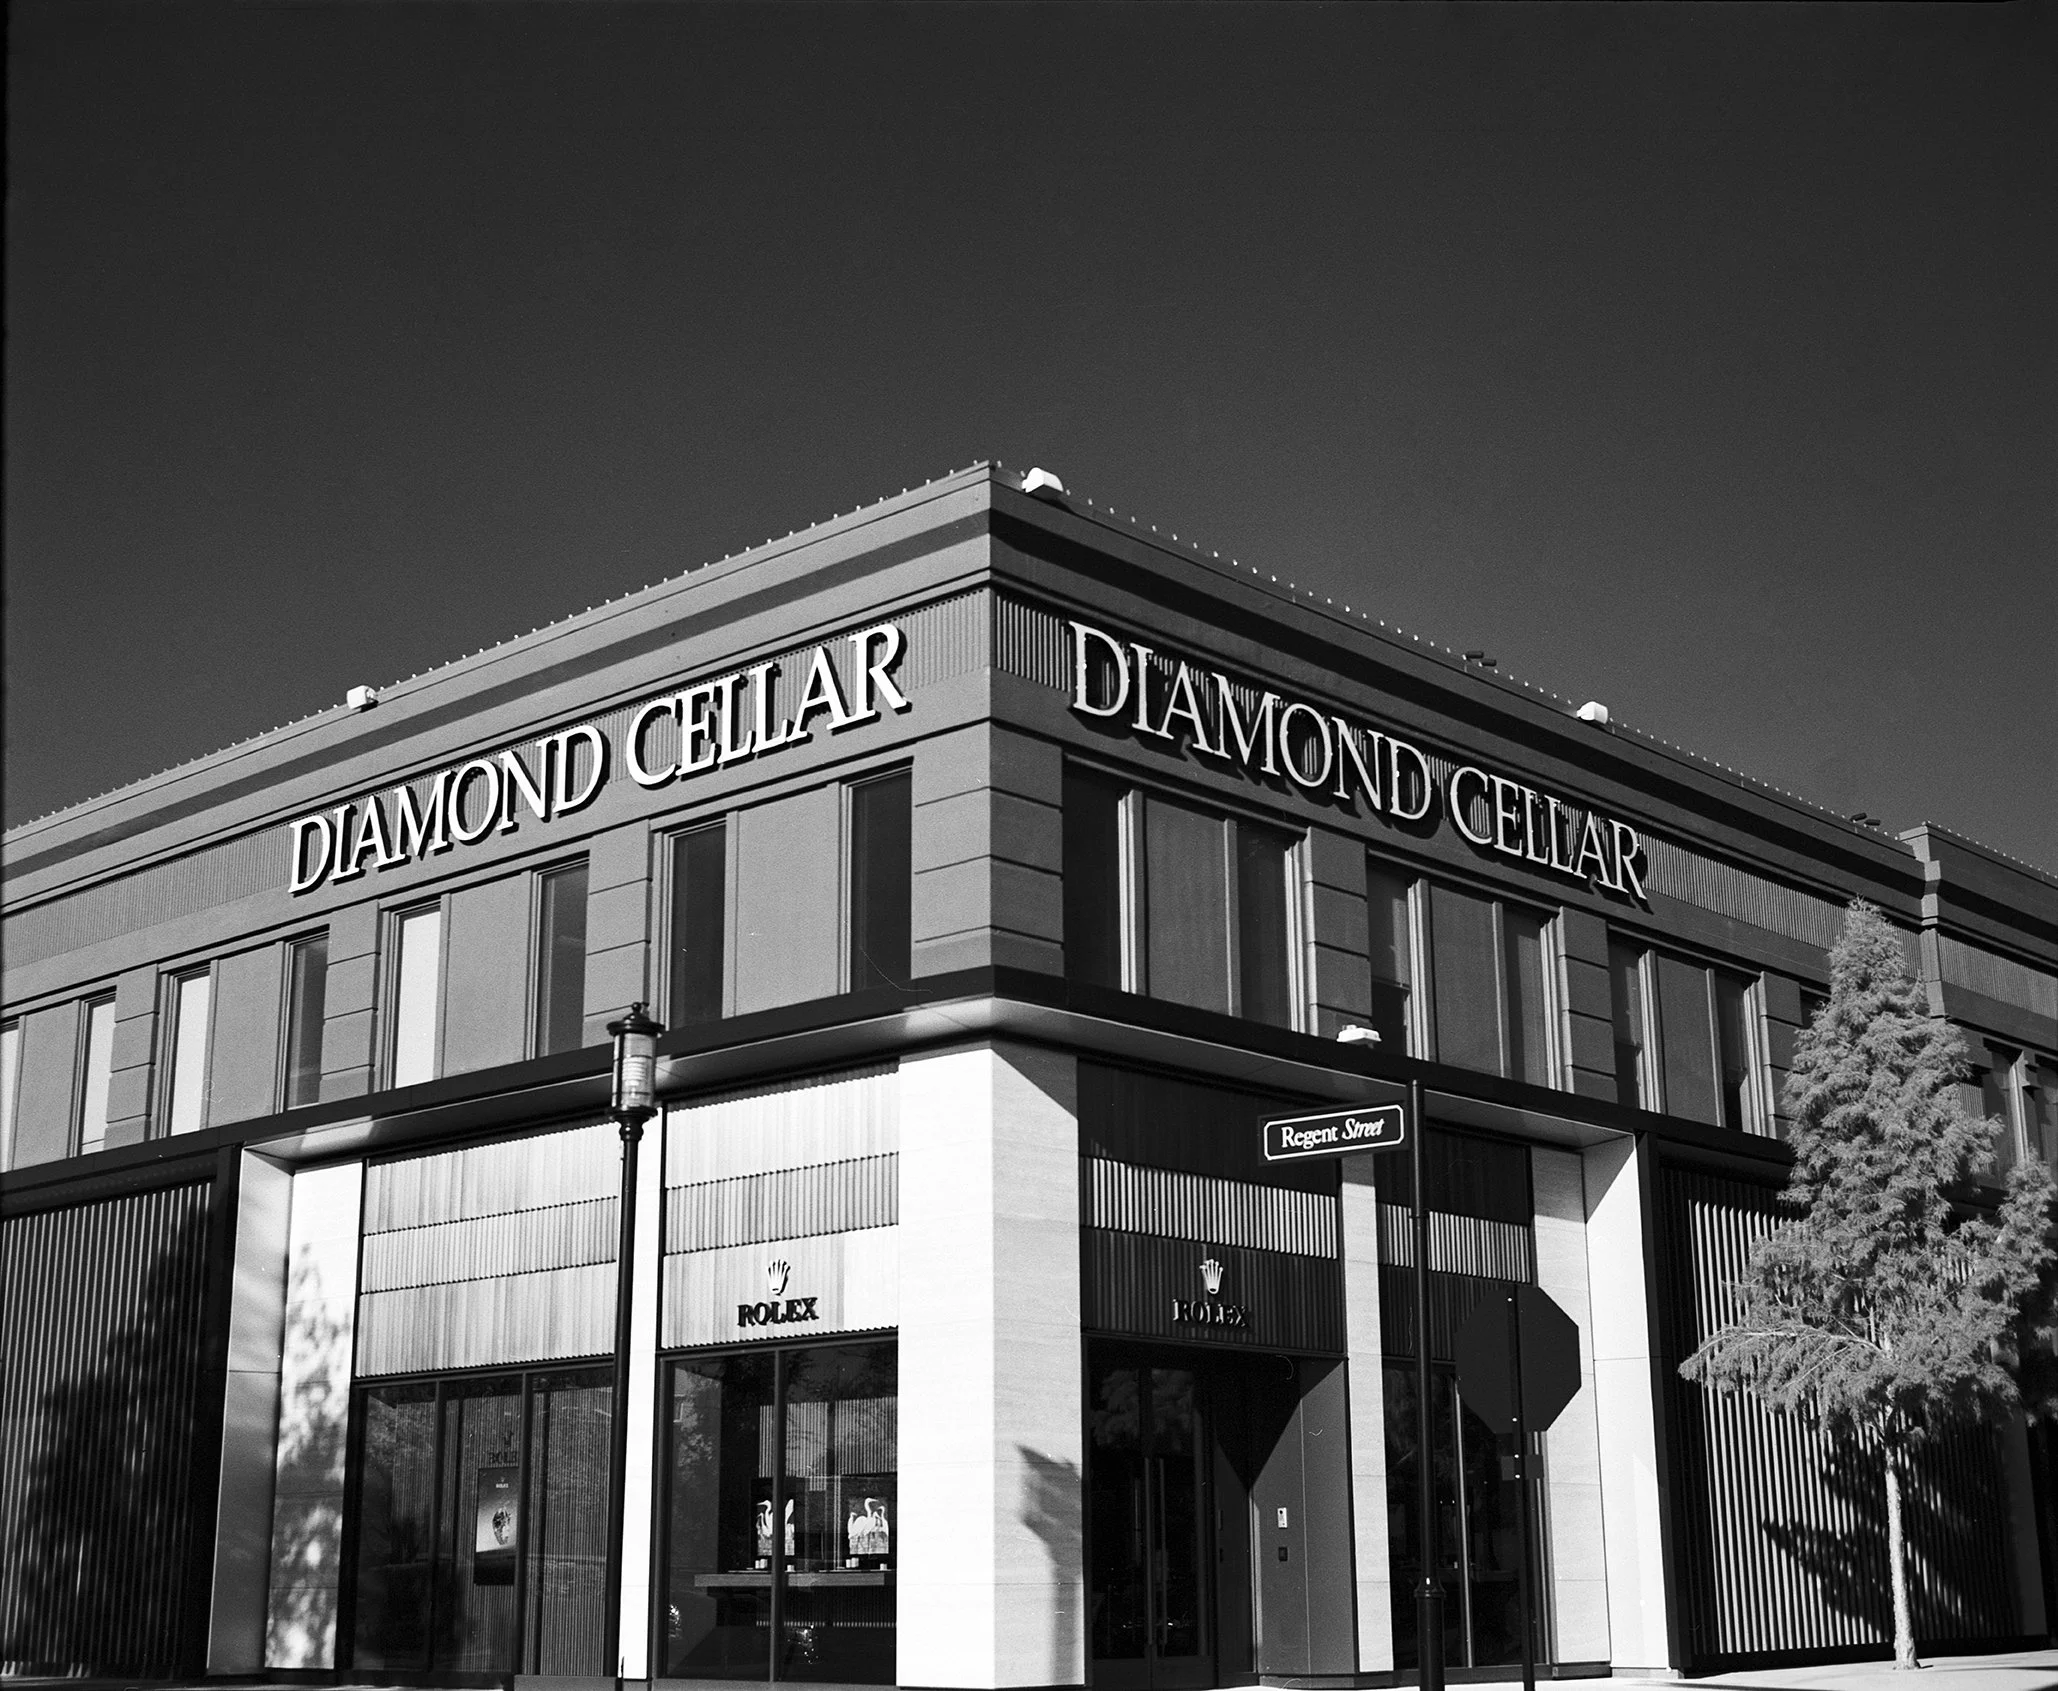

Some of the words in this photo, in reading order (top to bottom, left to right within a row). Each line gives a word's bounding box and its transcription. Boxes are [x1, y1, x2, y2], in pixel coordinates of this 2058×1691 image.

[288, 724, 604, 893] DIAMOND
[626, 623, 909, 786] CELLAR
[1069, 620, 1432, 820] DIAMOND
[1449, 766, 1648, 899] CELLAR
[1281, 1126, 1338, 1149] Regent
[1342, 1118, 1385, 1140] Street
[737, 1297, 820, 1328] ROLEX
[1172, 1299, 1248, 1328] ROLEX
